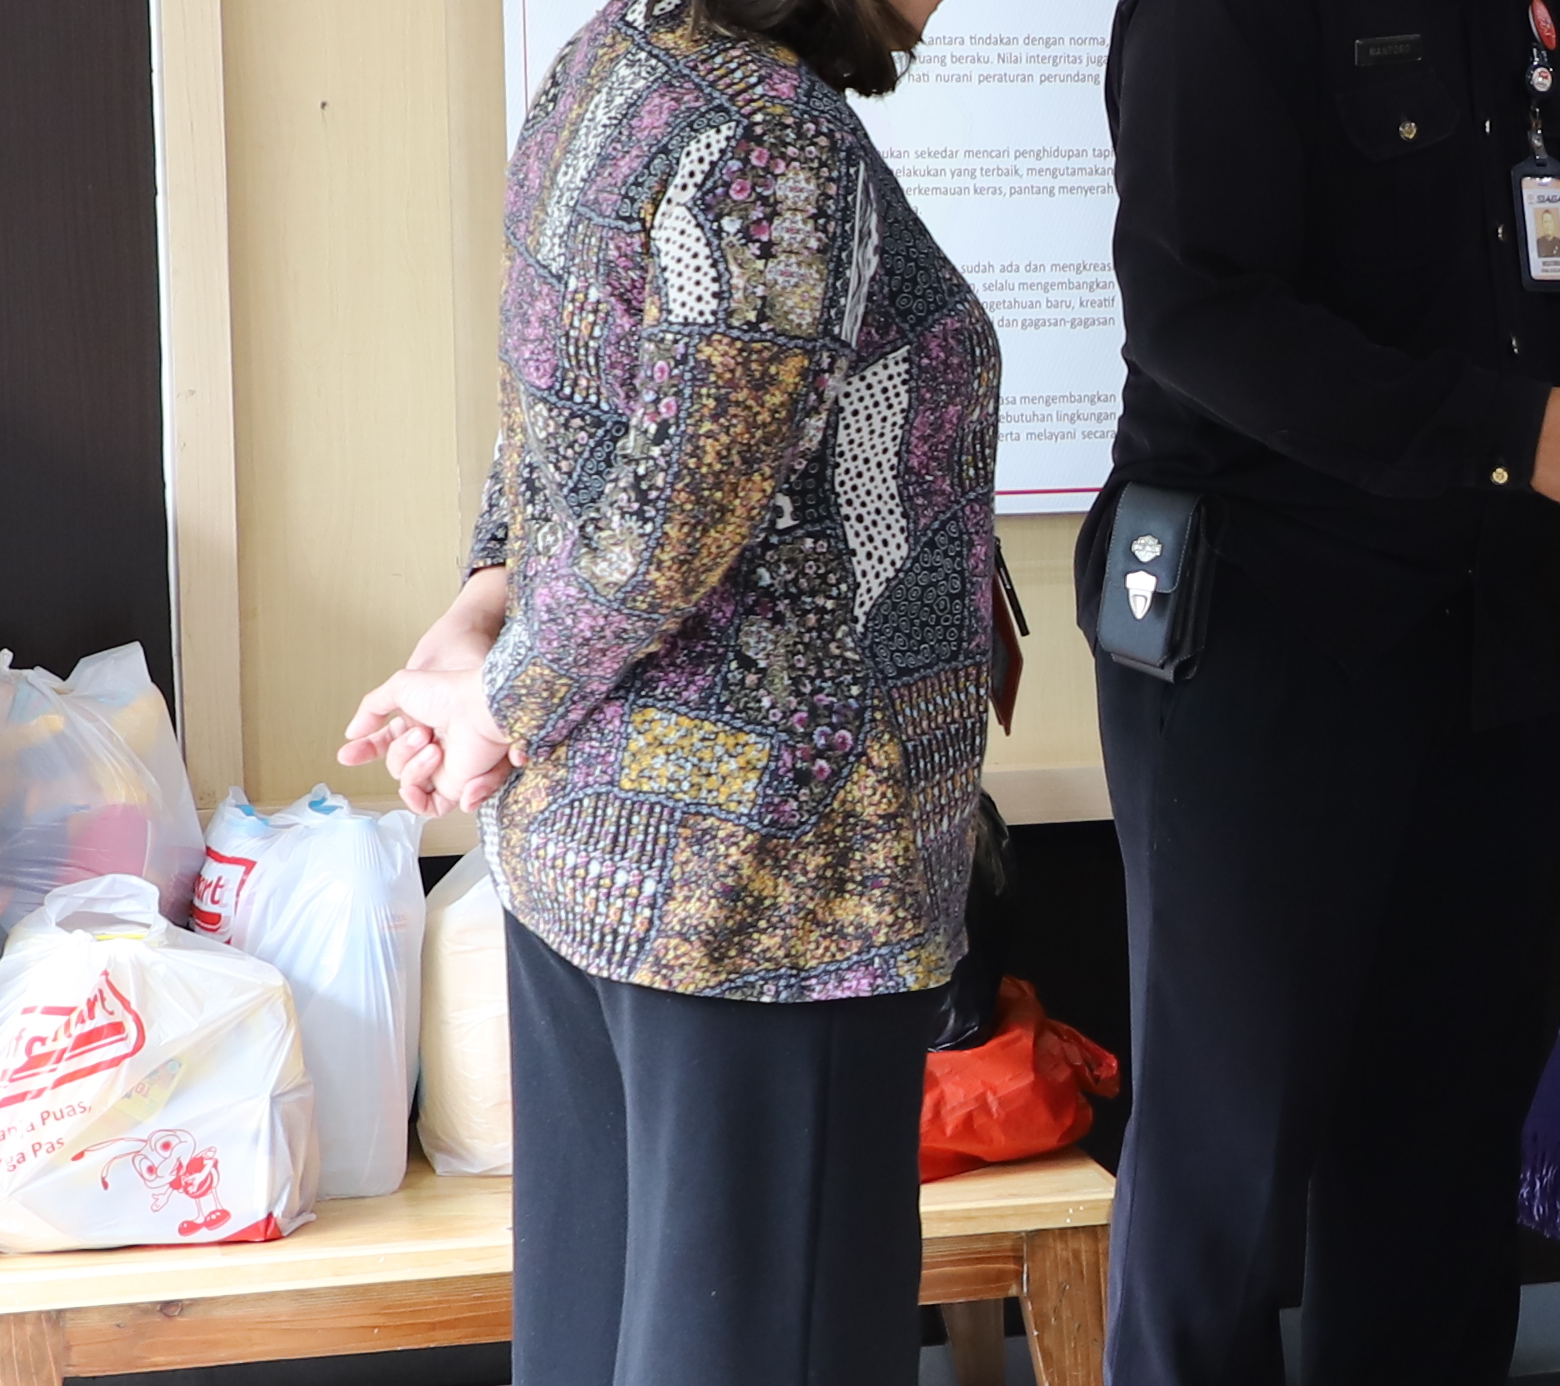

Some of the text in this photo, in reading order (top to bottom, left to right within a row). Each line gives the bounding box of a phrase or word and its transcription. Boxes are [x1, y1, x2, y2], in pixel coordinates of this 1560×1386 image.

[927, 33, 1065, 49] antara tindakan dengan
[997, 52, 1083, 67] Nilai intergritas
[977, 70, 1101, 86] peraturan perundang
[914, 146, 1088, 163] sekedar mencari penghidupan
[980, 164, 1114, 181] terbaik, mengutamakan
[1009, 183, 1114, 200] pantang menyerah
[1018, 278, 1115, 294] mengembangkan
[1078, 295, 1116, 309] kreatif
[1020, 316, 1115, 331] gagasan-gagasan
[40, 1099, 93, 1127] Puas,
[30, 1136, 66, 1158] Pas
